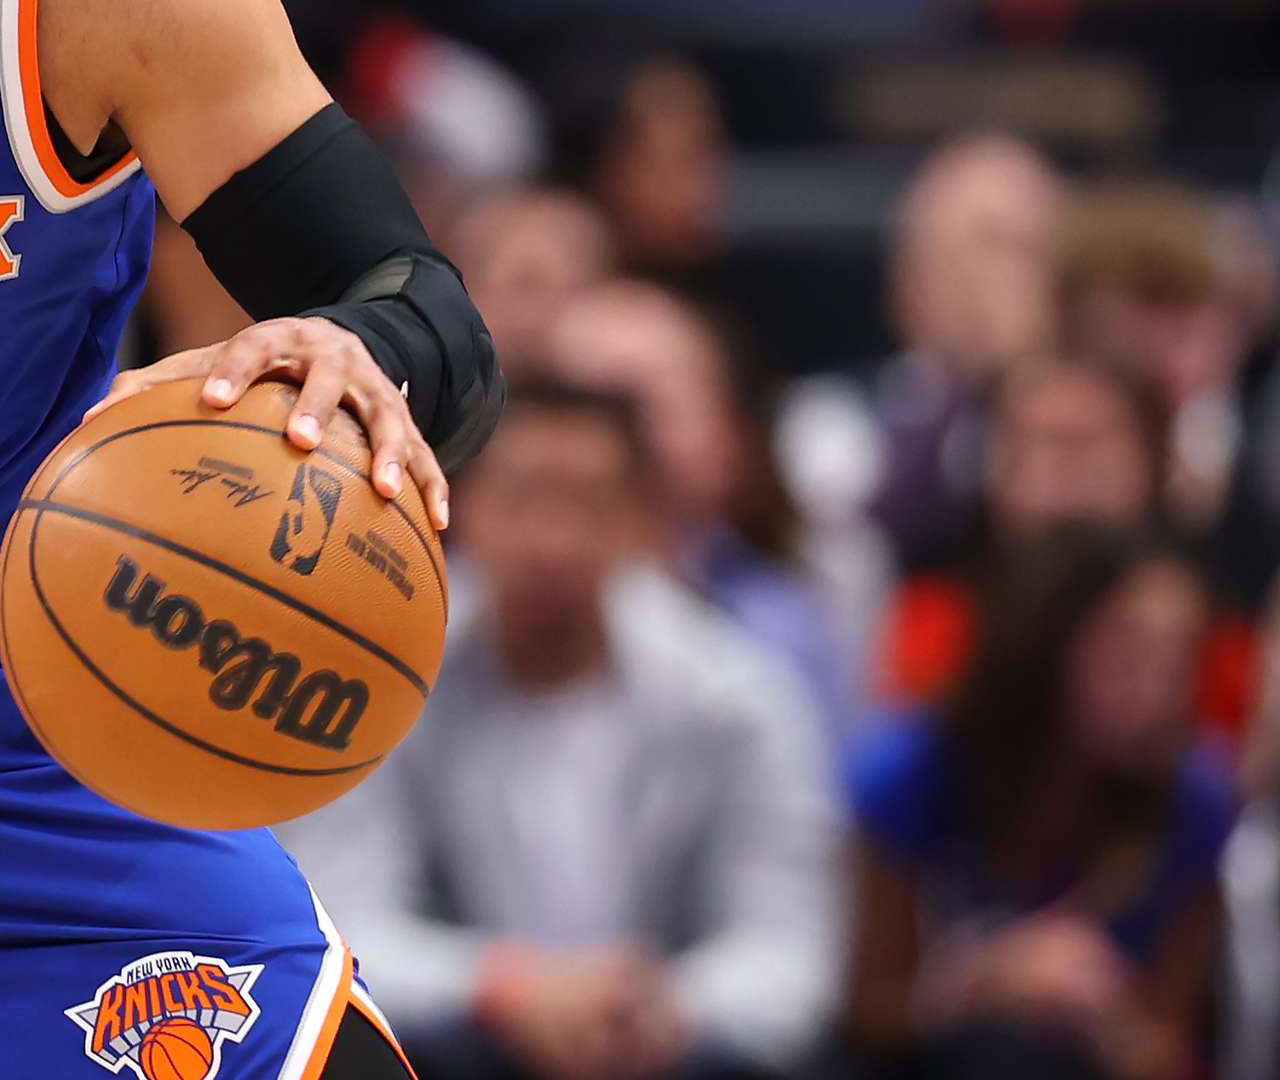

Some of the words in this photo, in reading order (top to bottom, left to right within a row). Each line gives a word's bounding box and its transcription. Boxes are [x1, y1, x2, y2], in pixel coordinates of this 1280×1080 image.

[101, 553, 371, 752] Wilson
[92, 962, 252, 1054] KNICKS
[126, 962, 154, 985] NEW
[155, 956, 193, 973] YORK
